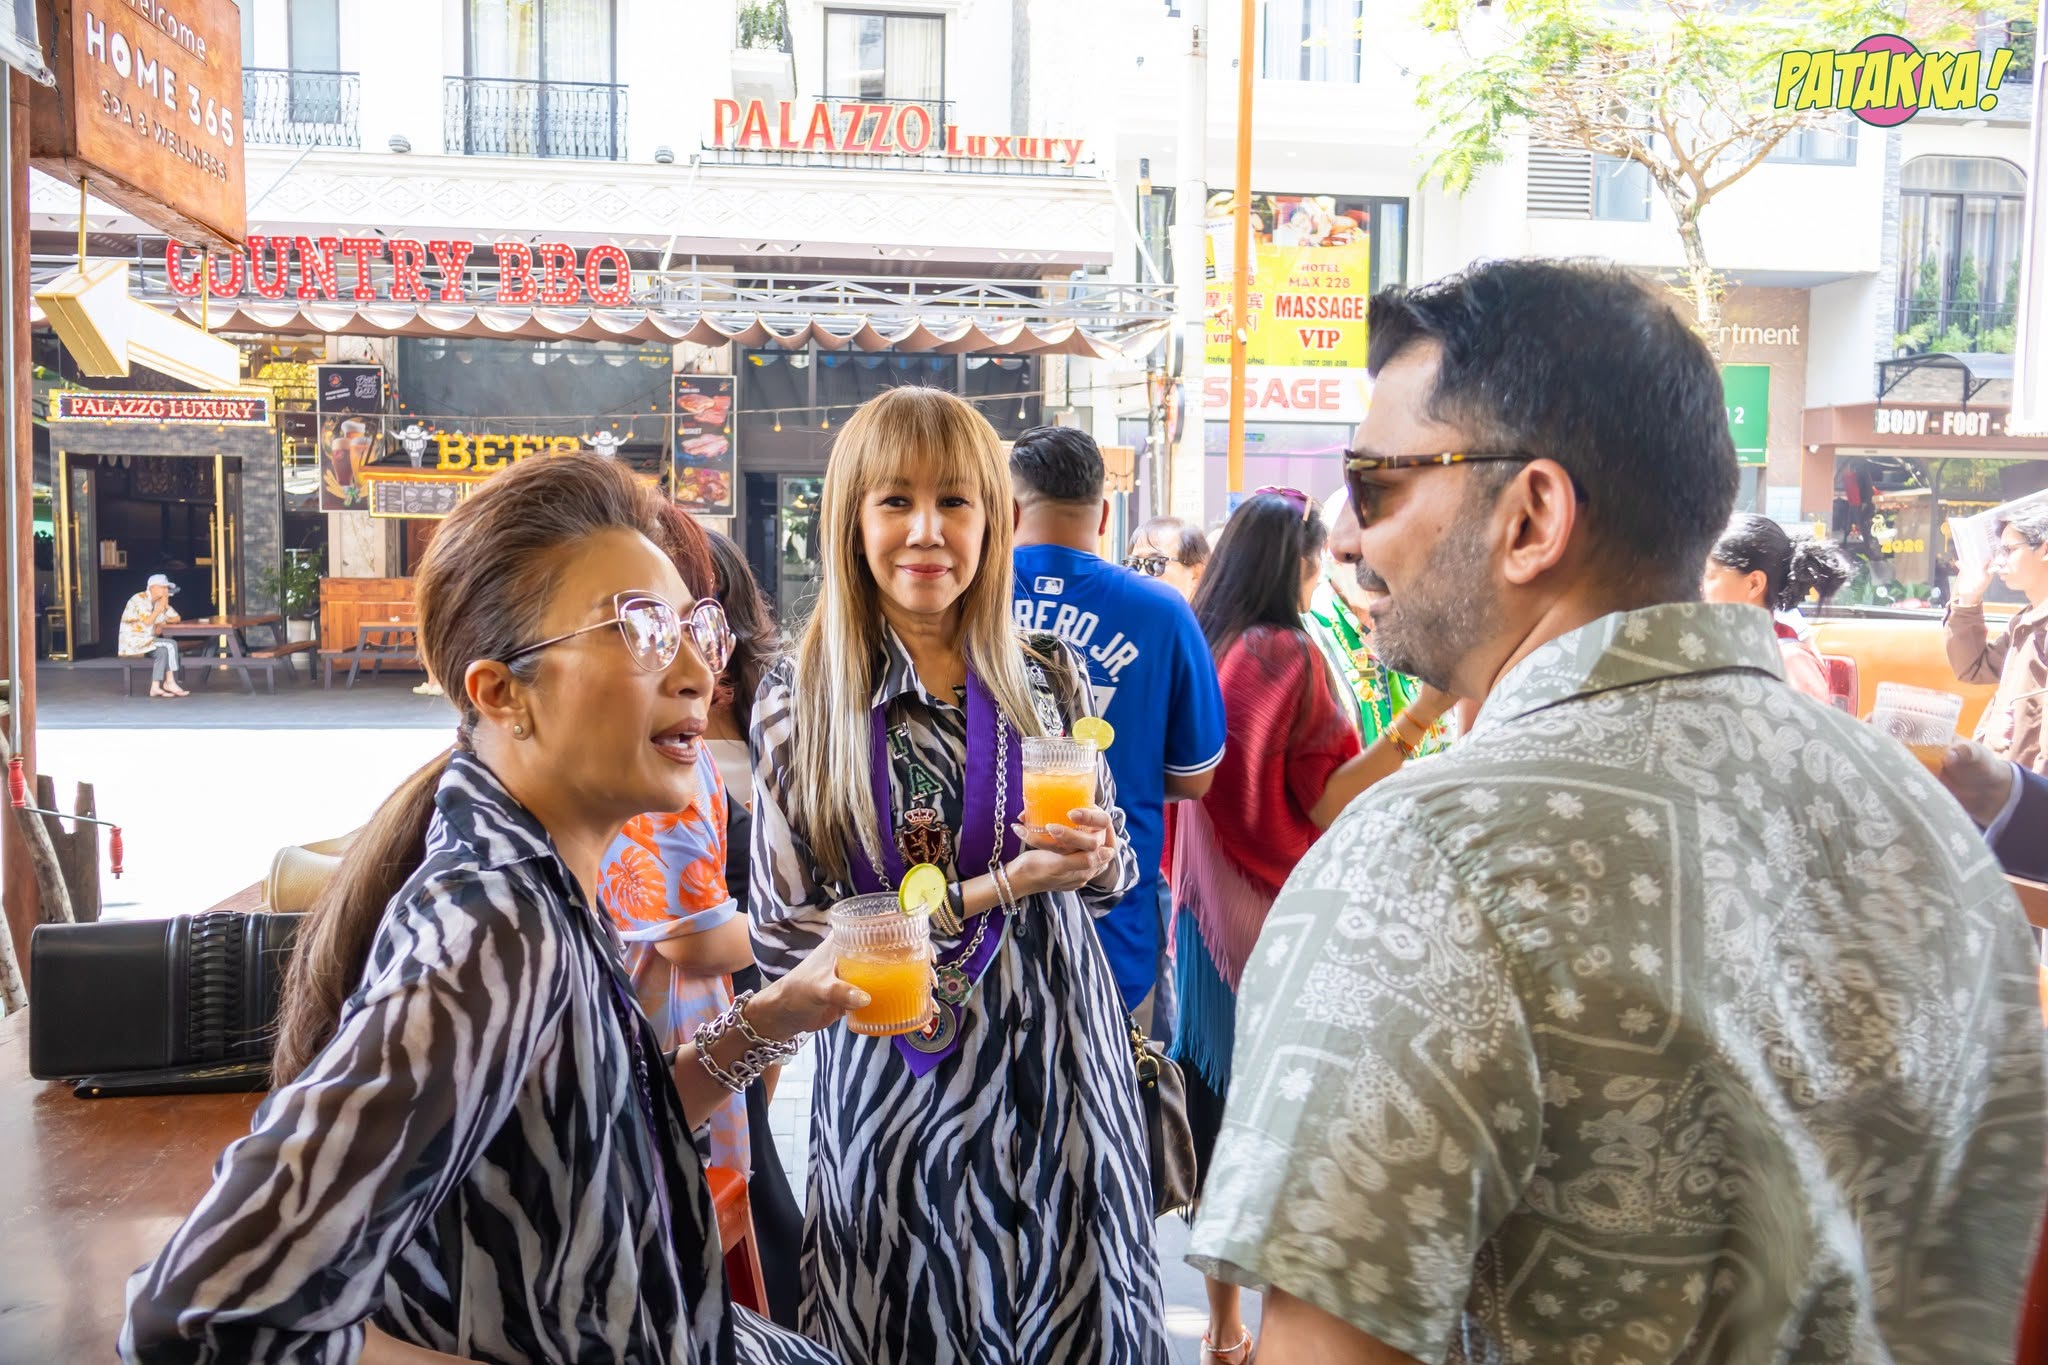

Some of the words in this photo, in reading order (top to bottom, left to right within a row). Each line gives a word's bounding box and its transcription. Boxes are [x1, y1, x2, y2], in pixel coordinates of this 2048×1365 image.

[129, 0, 207, 61] elcome
[86, 11, 178, 111] HOME
[187, 83, 235, 148] 365
[101, 89, 134, 128] SPA
[138, 112, 149, 137] &
[152, 120, 228, 183] WELLNESS
[712, 97, 933, 156] PALAZZO
[942, 124, 1085, 169] Luxury
[164, 234, 475, 304] COUNTRY
[492, 241, 631, 307] BBQ
[1288, 276, 1321, 288] MAX
[1325, 276, 1351, 289] 228
[1301, 263, 1341, 273] HOTEL
[1275, 294, 1364, 320] MASSAGE
[1298, 329, 1341, 349] VIP
[1719, 323, 1800, 346] rtment
[168, 400, 255, 419] LUXURY
[1877, 408, 1929, 435] BODY
[1942, 411, 1990, 437] FOOT
[1089, 631, 1140, 683] JR.
